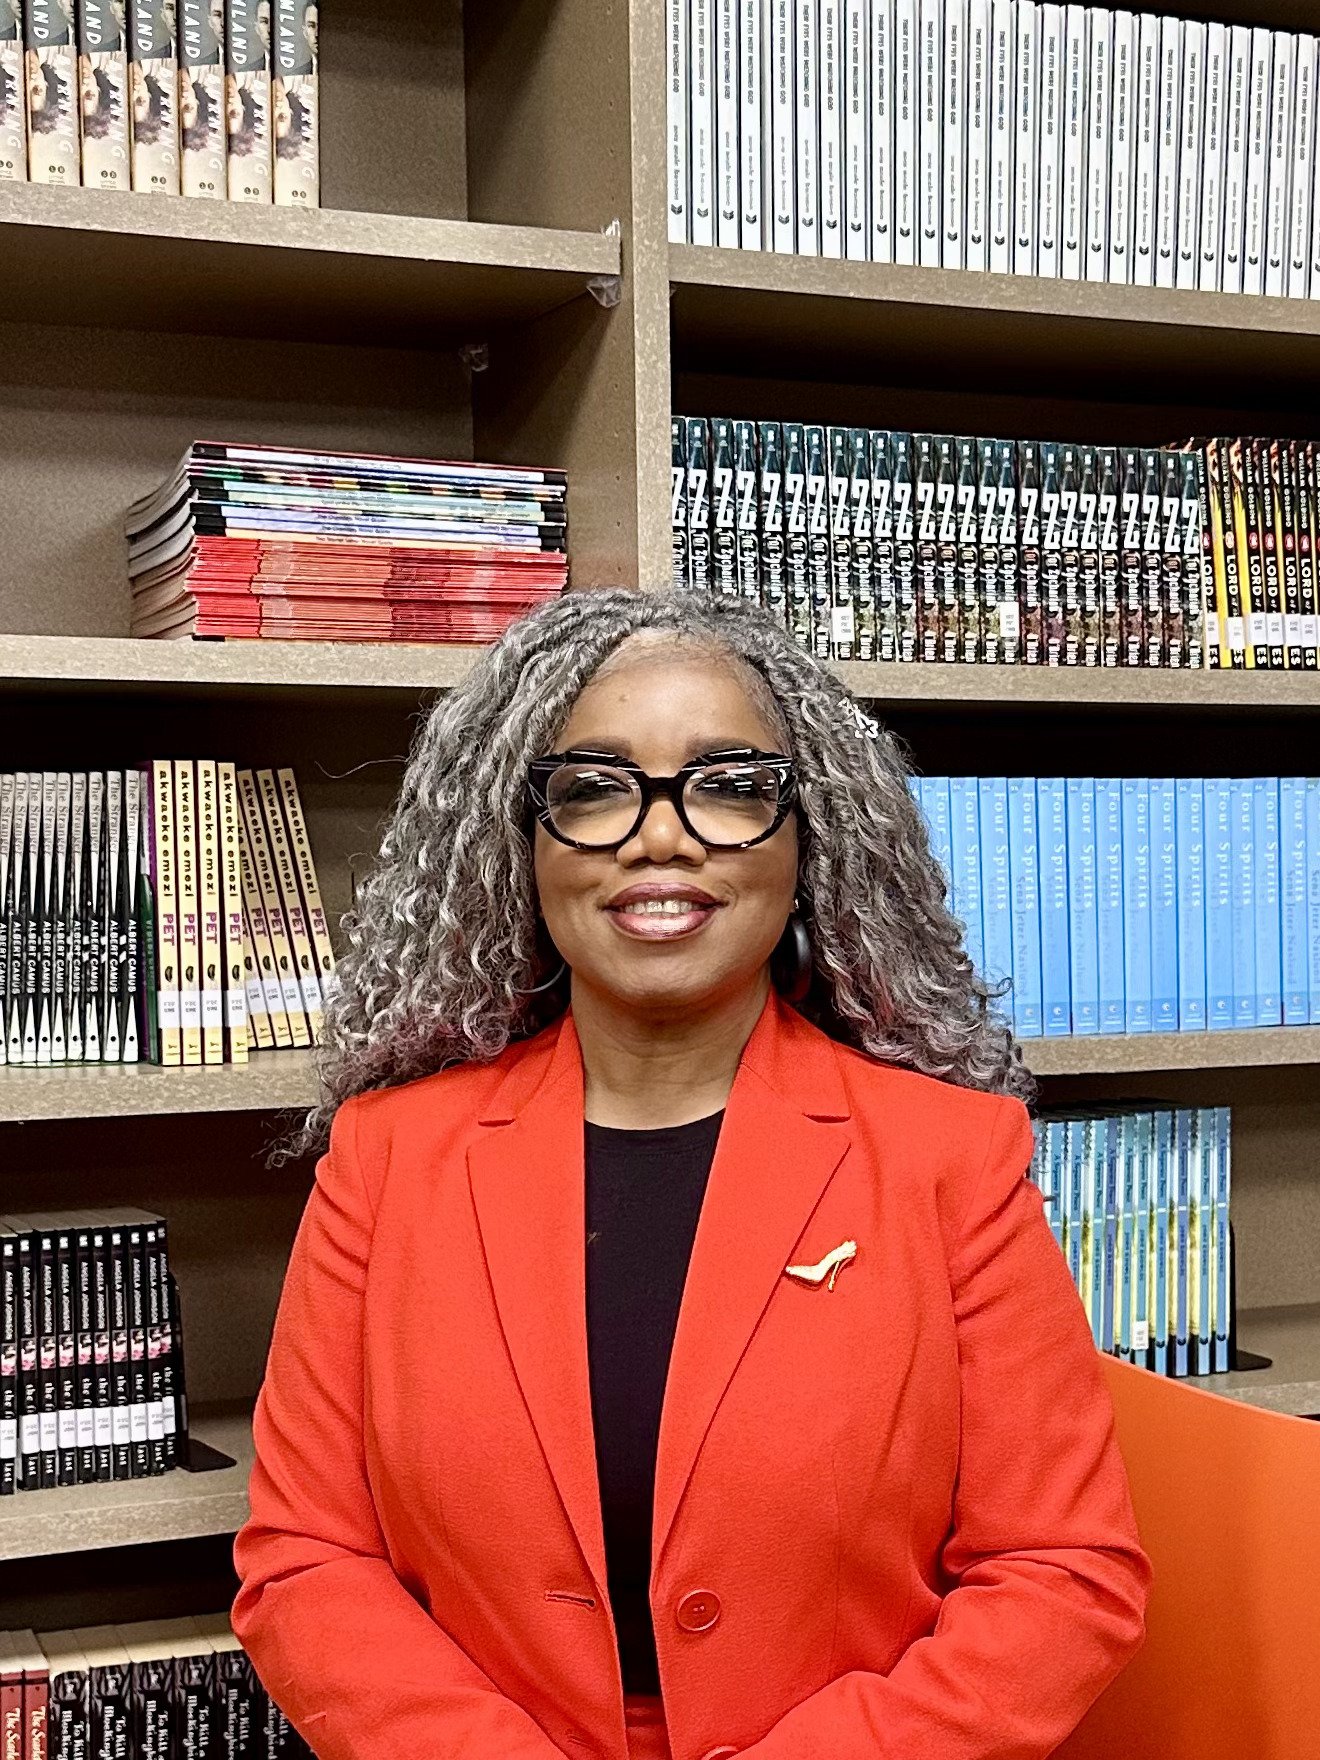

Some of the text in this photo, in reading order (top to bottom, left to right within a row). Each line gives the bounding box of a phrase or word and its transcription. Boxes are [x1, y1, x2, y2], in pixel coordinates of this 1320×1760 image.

[58, 55, 73, 153] BURNING
[110, 61, 125, 160] BURNING
[161, 66, 175, 163] BURNING
[208, 73, 222, 170] BURNING
[255, 79, 269, 175] BURNING
[302, 83, 316, 180] BURNING
[1245, 448, 1256, 525] WILLIAM GOLDING
[1262, 450, 1272, 526] WILLIAM GOLDING
[1282, 451, 1292, 528] WILLIAM GOLDING
[1250, 556, 1262, 596] LORD
[1266, 557, 1277, 597] LORD
[1285, 557, 1296, 597] LORD
[28, 781, 40, 856] The Stranger
[42, 781, 54, 857] The Stranger
[56, 781, 68, 856] The Stranger
[90, 780, 101, 856] The Stranger
[108, 780, 120, 856] The Stranger
[159, 770, 172, 897] akwaeke emezi
[181, 770, 194, 897] akwaeke emezi
[203, 770, 216, 896] akwaeke emezi
[224, 772, 238, 897] akwaeke emezi
[264, 779, 296, 894] akwaeke emezi
[284, 780, 317, 894] akwaeke emezi
[964, 792, 979, 910] Four Spirits
[993, 792, 1008, 910] Four Spirits
[1022, 792, 1037, 910] Four Spirits
[1050, 792, 1066, 909] Four Spirits
[1136, 792, 1149, 909] Four Spirits
[1189, 792, 1202, 907] Four Spirits
[28, 920, 37, 993] ALBERT CAMUS
[42, 921, 51, 994] ALBERT CAMUS
[56, 921, 66, 993] ALBERT CAMUS
[90, 920, 98, 992] ALBERT CAMUS
[110, 920, 118, 992] ALBERT CAMUS
[164, 914, 174, 946] PET
[184, 914, 195, 946] PET
[206, 912, 218, 944] PET
[230, 913, 240, 945] PET
[290, 907, 305, 937] PET
[312, 908, 326, 937] PET
[96, 1262, 106, 1329] ANGELA JOHNSON
[114, 1260, 123, 1327] ANGELA JOHNSON
[132, 1258, 142, 1326] ANGELA JOHNSON
[98, 1378, 108, 1394] the
[117, 1376, 126, 1392] the
[136, 1374, 145, 1390] the
[6, 1708, 20, 1728] The
[32, 1706, 46, 1727] The
[116, 1716, 126, 1758] To Kill
[158, 1711, 168, 1726] To
[158, 1729, 168, 1752] Kill
[199, 1706, 209, 1758] To Kill a
[240, 1700, 250, 1714] To
[240, 1717, 250, 1740] Kill
